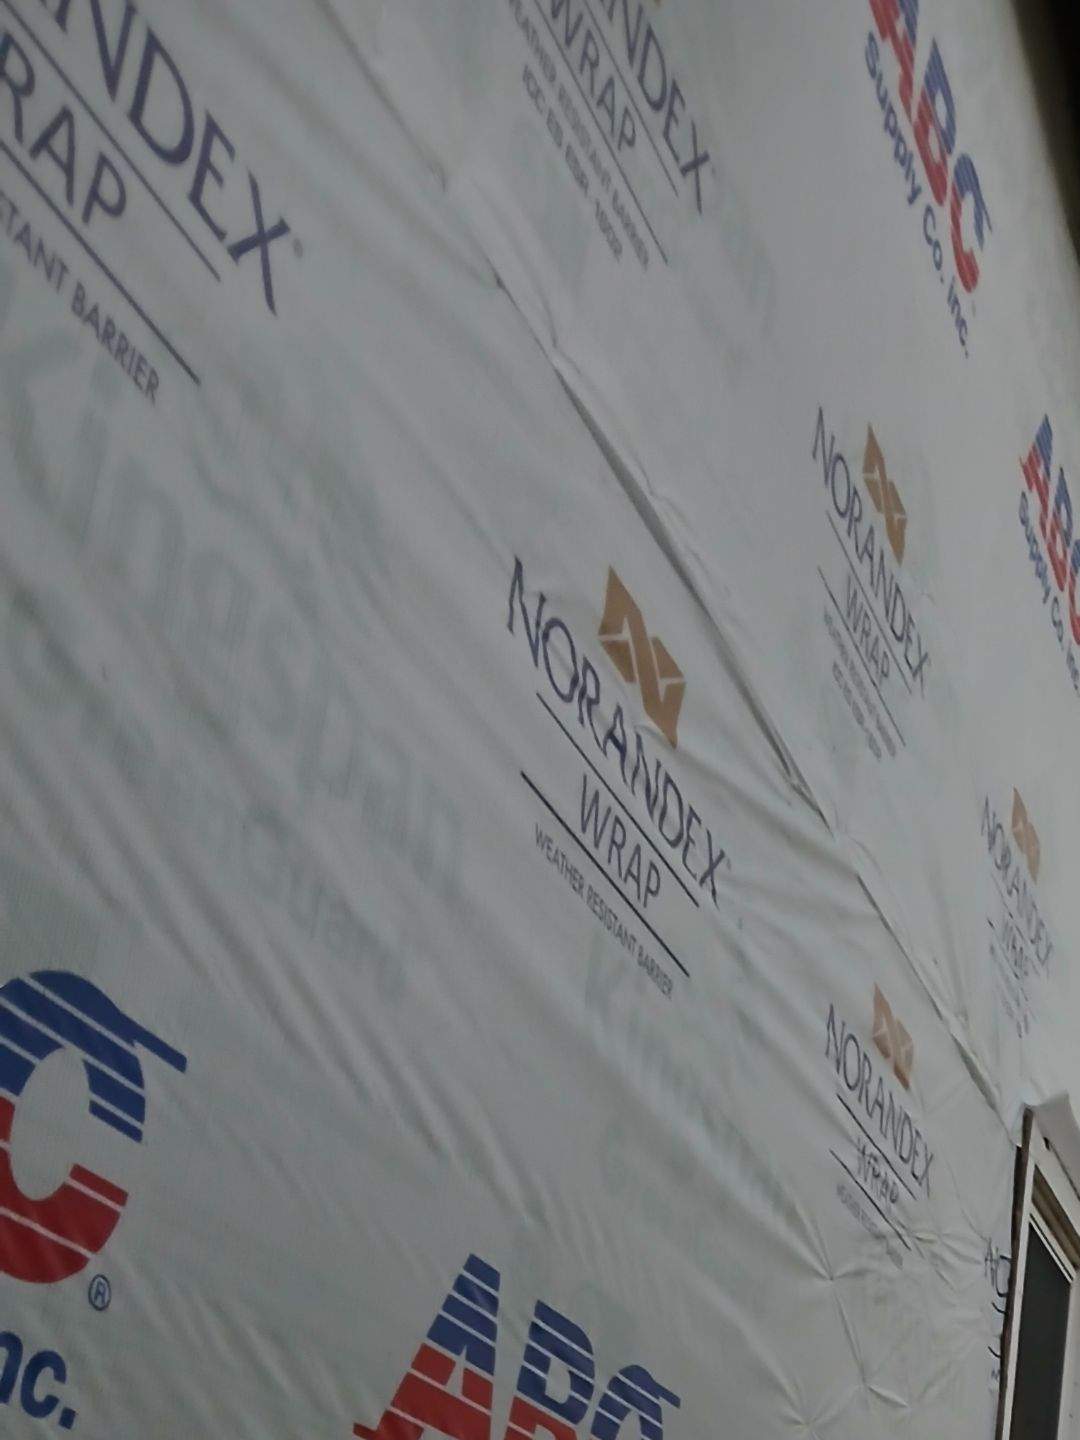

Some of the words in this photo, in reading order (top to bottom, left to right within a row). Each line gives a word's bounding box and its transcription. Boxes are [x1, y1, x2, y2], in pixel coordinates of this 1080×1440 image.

[44, 0, 292, 318] NDEX
[603, 0, 710, 218] NDEX
[864, 31, 922, 206] Supply
[70, 280, 161, 405] BARRIER
[811, 400, 929, 699] NORANDEX
[508, 556, 728, 911] NORANDEX
[534, 821, 587, 901] WEATHER
[580, 773, 662, 909] WRAP
